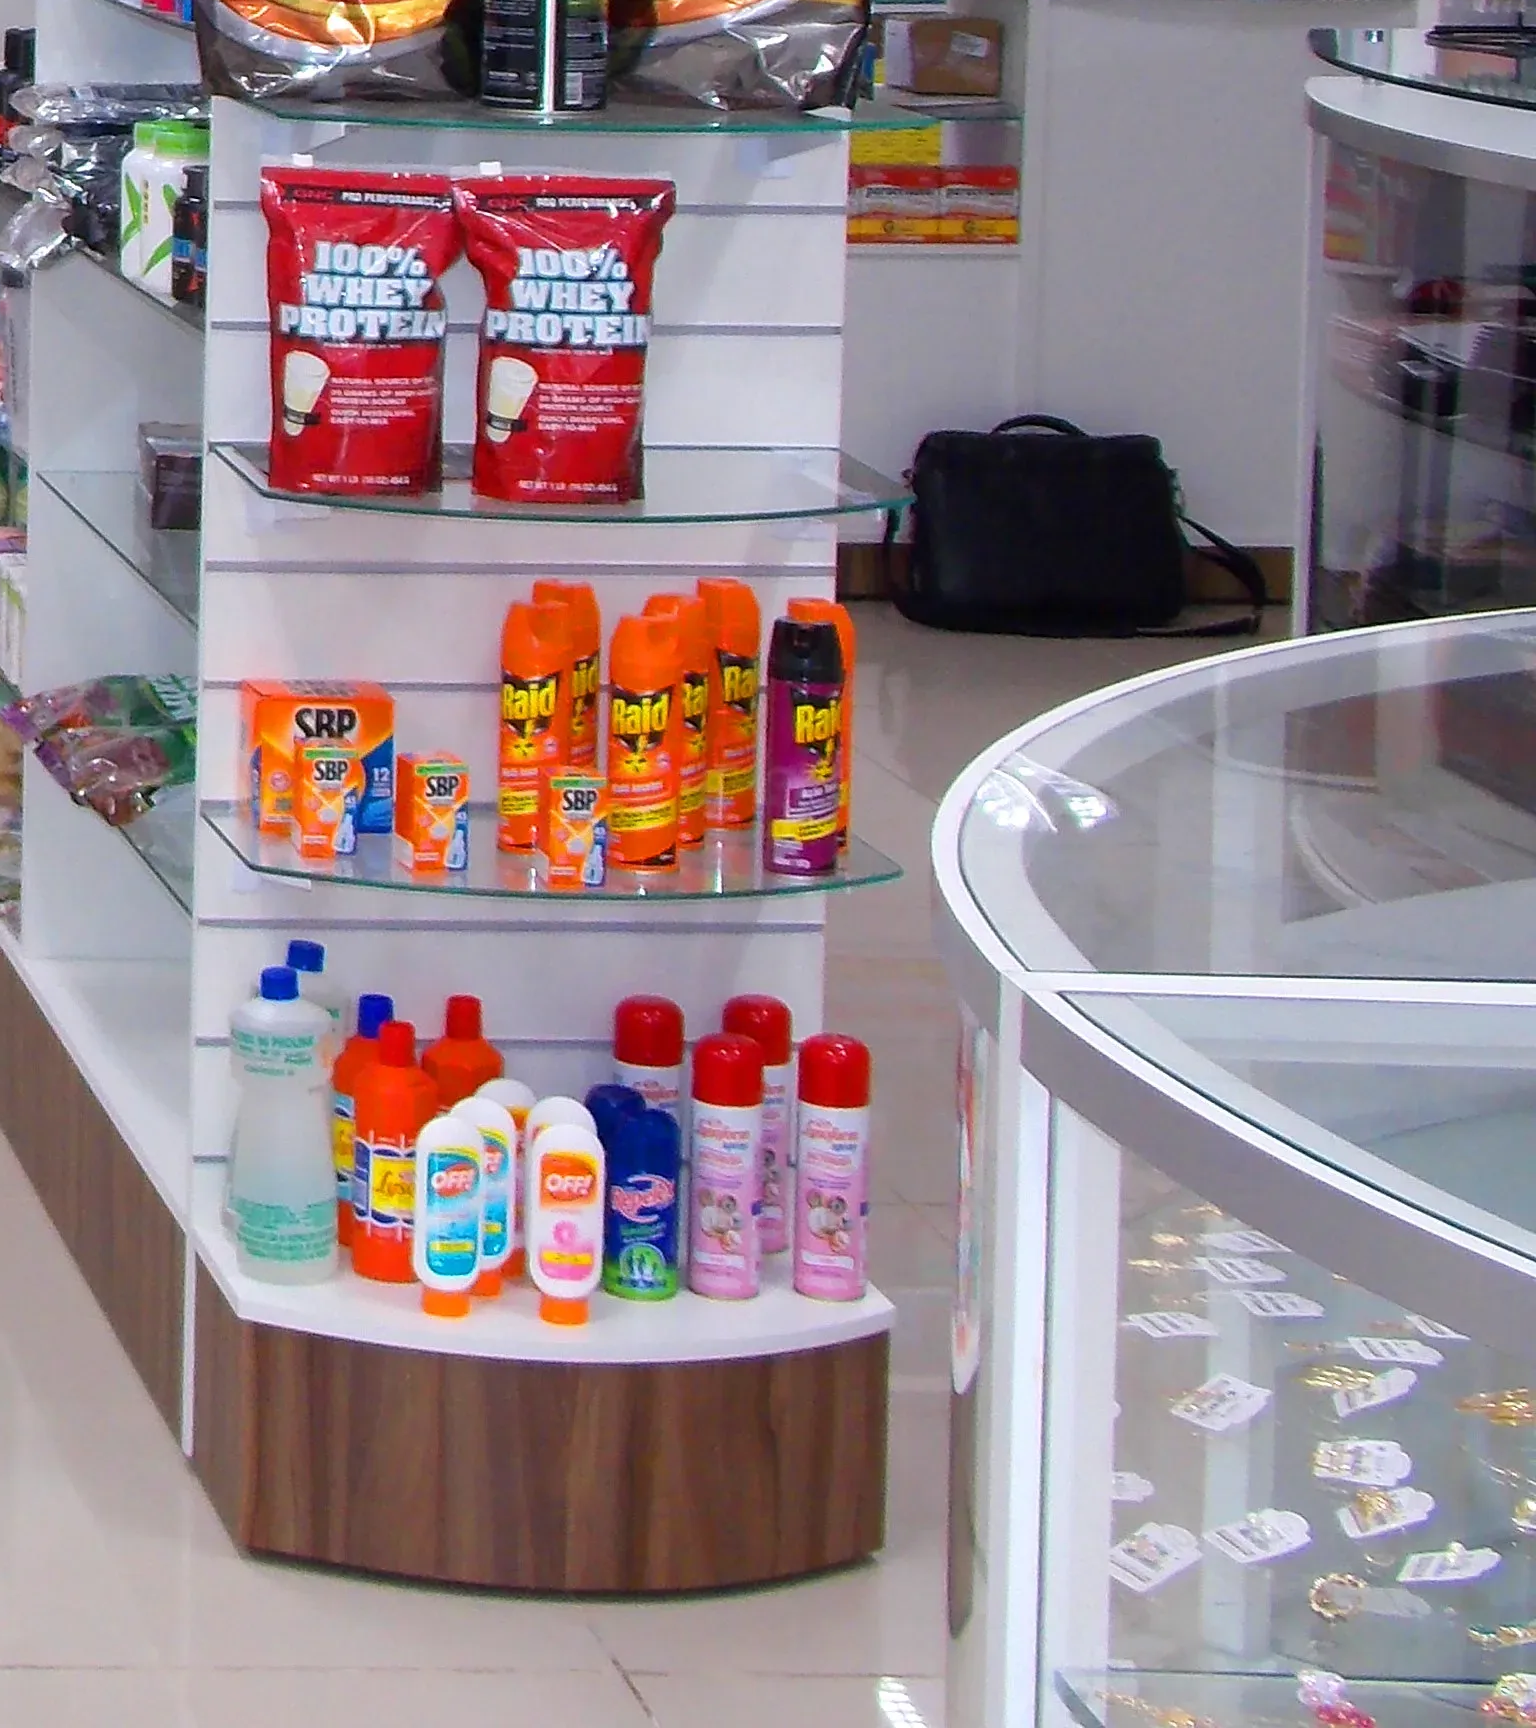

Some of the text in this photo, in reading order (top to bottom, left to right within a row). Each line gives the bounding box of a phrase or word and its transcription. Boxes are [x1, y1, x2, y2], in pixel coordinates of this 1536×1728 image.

[314, 239, 429, 277] 100%
[516, 246, 630, 280] 100%
[304, 272, 435, 308] WHEY
[510, 277, 636, 312] WHEY
[279, 303, 447, 340] PROTEIN
[502, 676, 557, 720] Raid
[612, 693, 670, 735] Raid
[294, 707, 357, 739] SBP
[314, 759, 348, 781] SBP
[372, 767, 390, 782] 12
[425, 775, 459, 797] SBP
[562, 789, 598, 812] SBP
[431, 1169, 476, 1192] OFF!
[544, 1173, 594, 1196] OFF!
